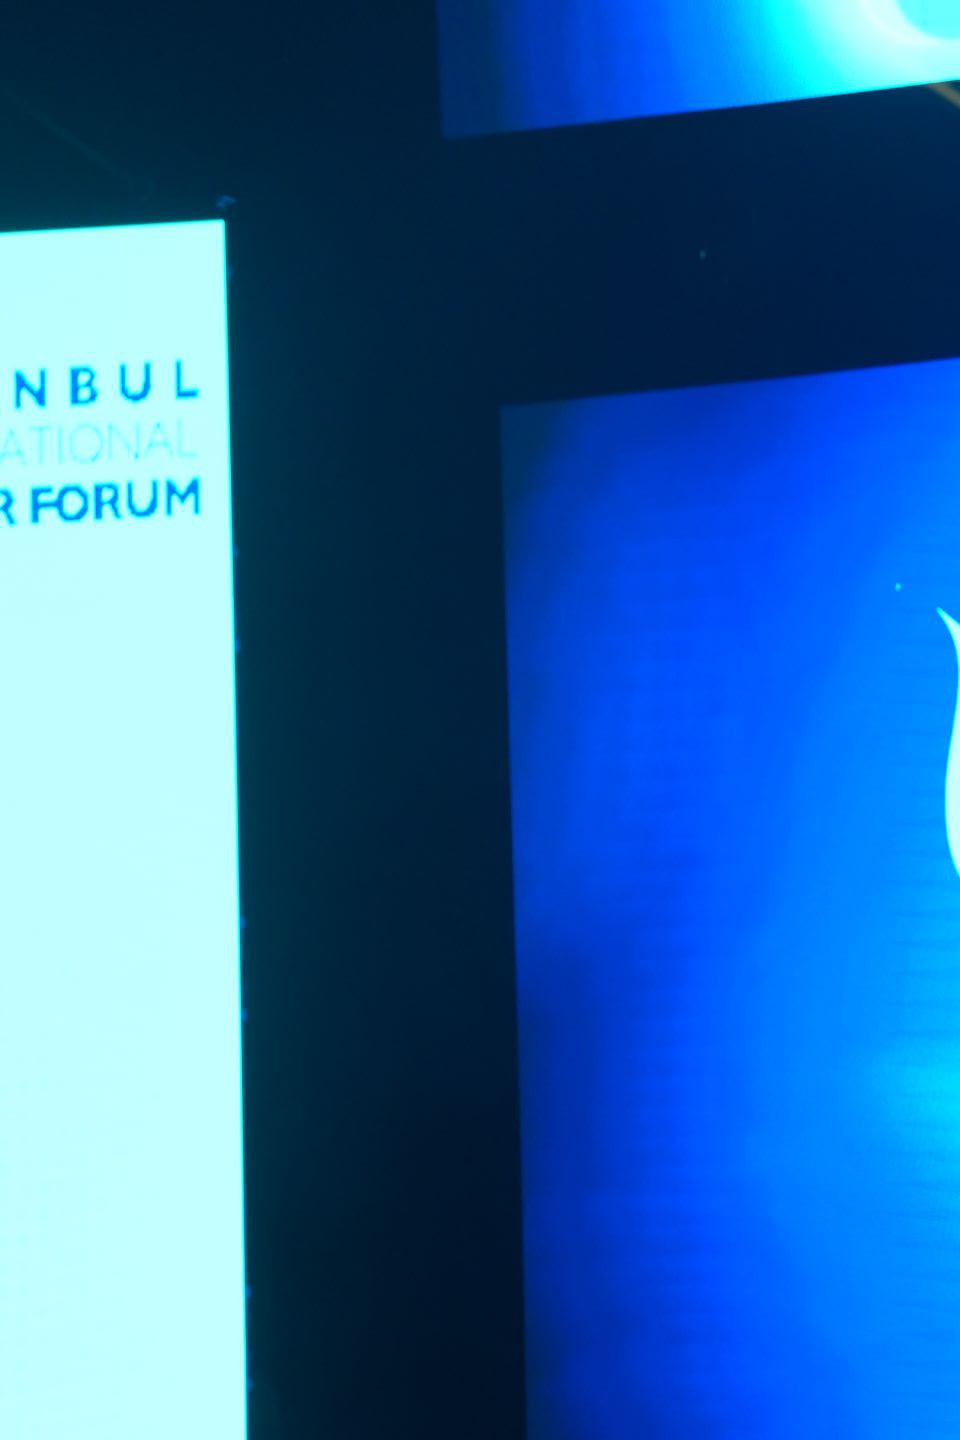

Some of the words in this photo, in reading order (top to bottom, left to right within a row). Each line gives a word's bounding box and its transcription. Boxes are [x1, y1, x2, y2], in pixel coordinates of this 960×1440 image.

[14, 358, 200, 409] NBUL
[0, 418, 199, 467] ATIONAL
[31, 474, 201, 523] FORUM
